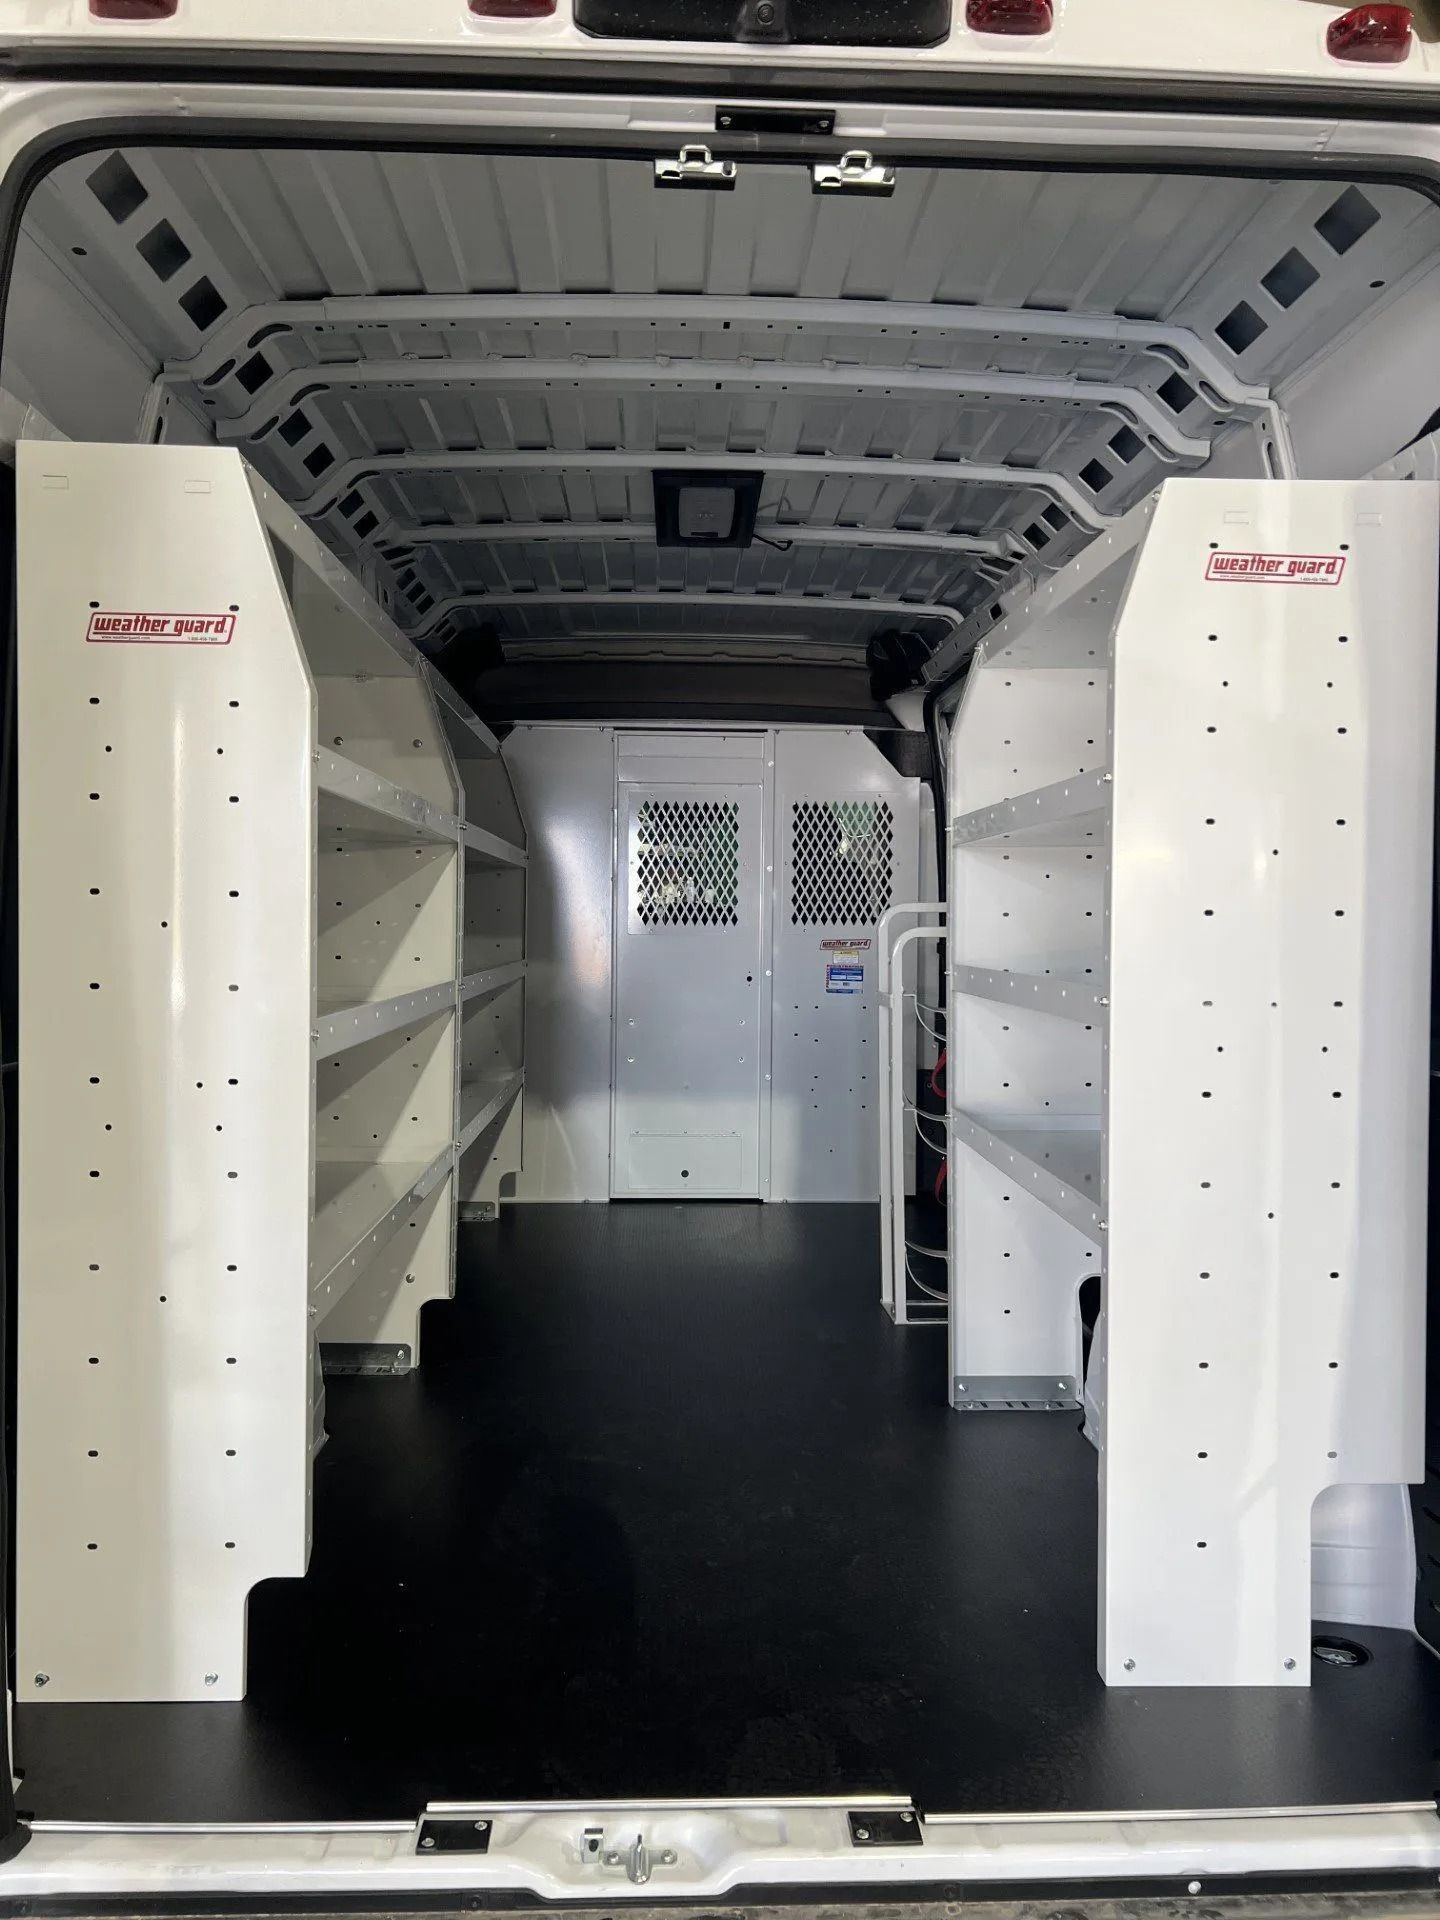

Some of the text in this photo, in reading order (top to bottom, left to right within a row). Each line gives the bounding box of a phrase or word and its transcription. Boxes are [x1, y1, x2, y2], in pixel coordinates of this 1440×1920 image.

[1214, 555, 1337, 576] weather guard
[94, 616, 227, 636] weather guard
